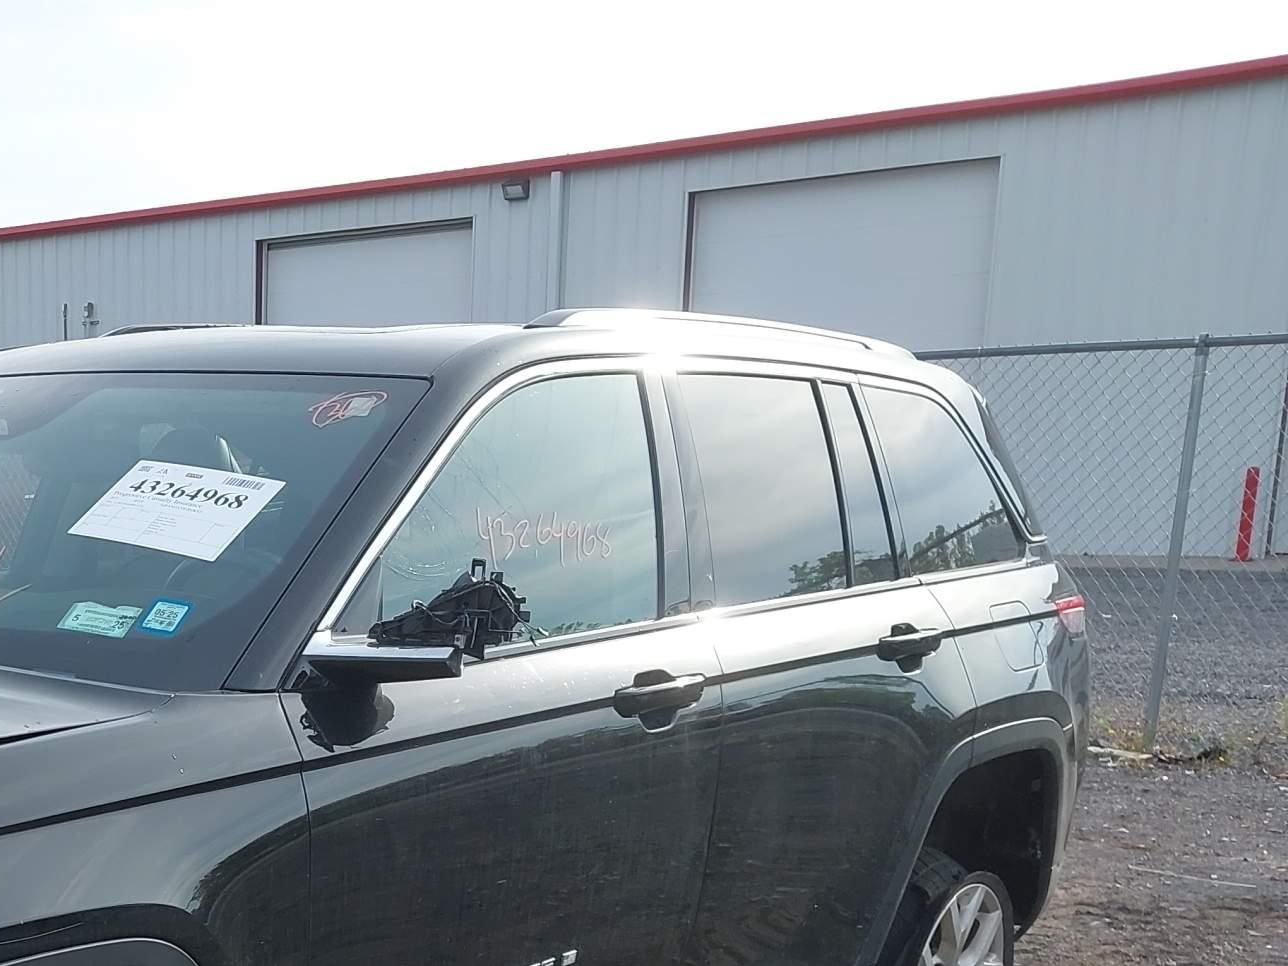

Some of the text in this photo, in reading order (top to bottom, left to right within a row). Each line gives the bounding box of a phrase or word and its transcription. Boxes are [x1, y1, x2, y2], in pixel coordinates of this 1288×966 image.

[129, 478, 250, 511] 43264968
[475, 506, 613, 570] 43264968
[71, 613, 81, 622] 5
[111, 620, 125, 630] 25
